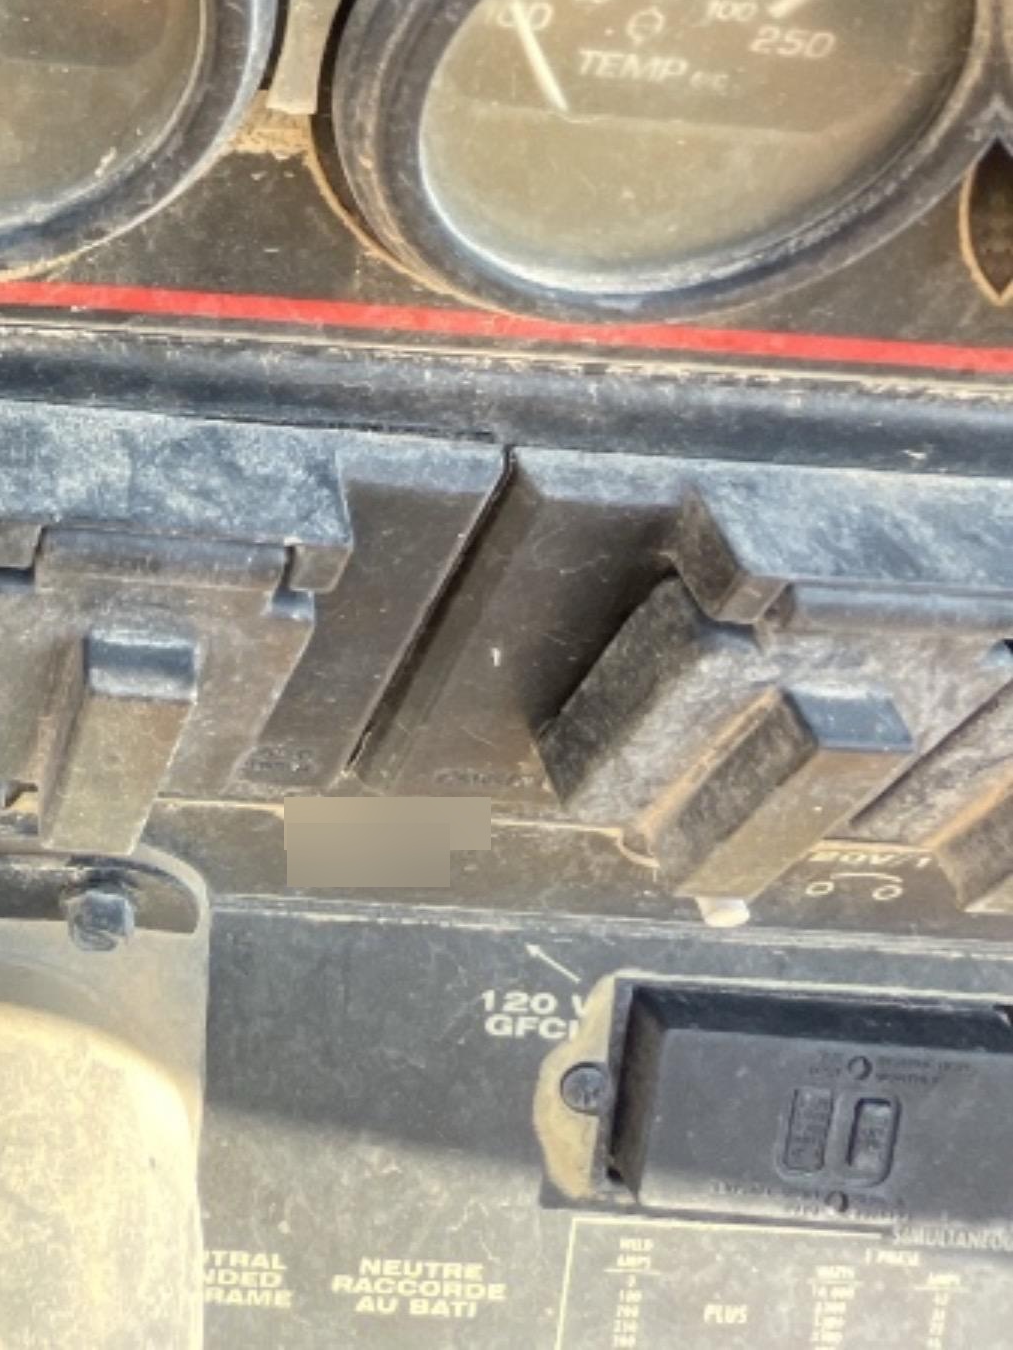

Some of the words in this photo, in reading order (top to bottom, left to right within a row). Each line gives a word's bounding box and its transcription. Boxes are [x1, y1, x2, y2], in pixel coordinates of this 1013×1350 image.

[750, 25, 836, 58] 250
[579, 50, 689, 82] TEMP
[482, 990, 558, 1015] 120
[360, 1257, 484, 1282] NEUTRE
[331, 1274, 507, 1301] RACCORDE
[355, 1296, 398, 1315] AU
[409, 1298, 477, 1319] BATI
[703, 1303, 748, 1325] PLUS
